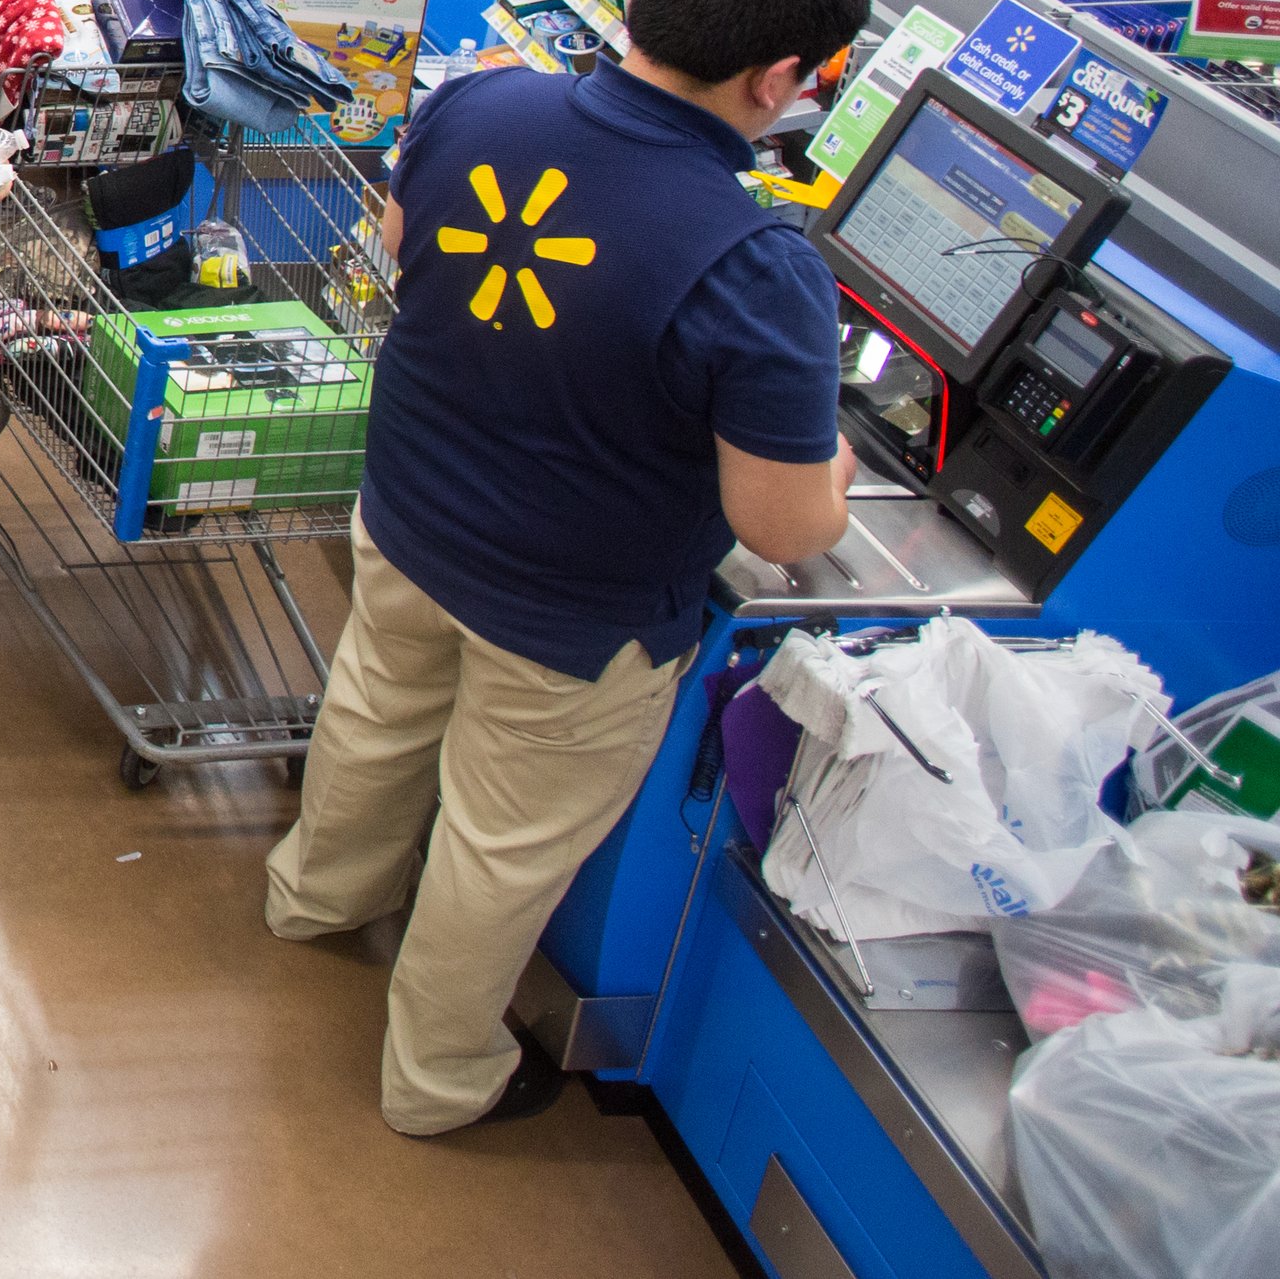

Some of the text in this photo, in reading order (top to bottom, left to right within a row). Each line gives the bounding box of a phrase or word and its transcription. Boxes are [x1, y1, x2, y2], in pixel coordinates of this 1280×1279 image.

[957, 51, 1024, 100] debit cards only.
[969, 37, 1031, 81] Cash, credit, or
[1071, 69, 1155, 128] CASH QUICK
